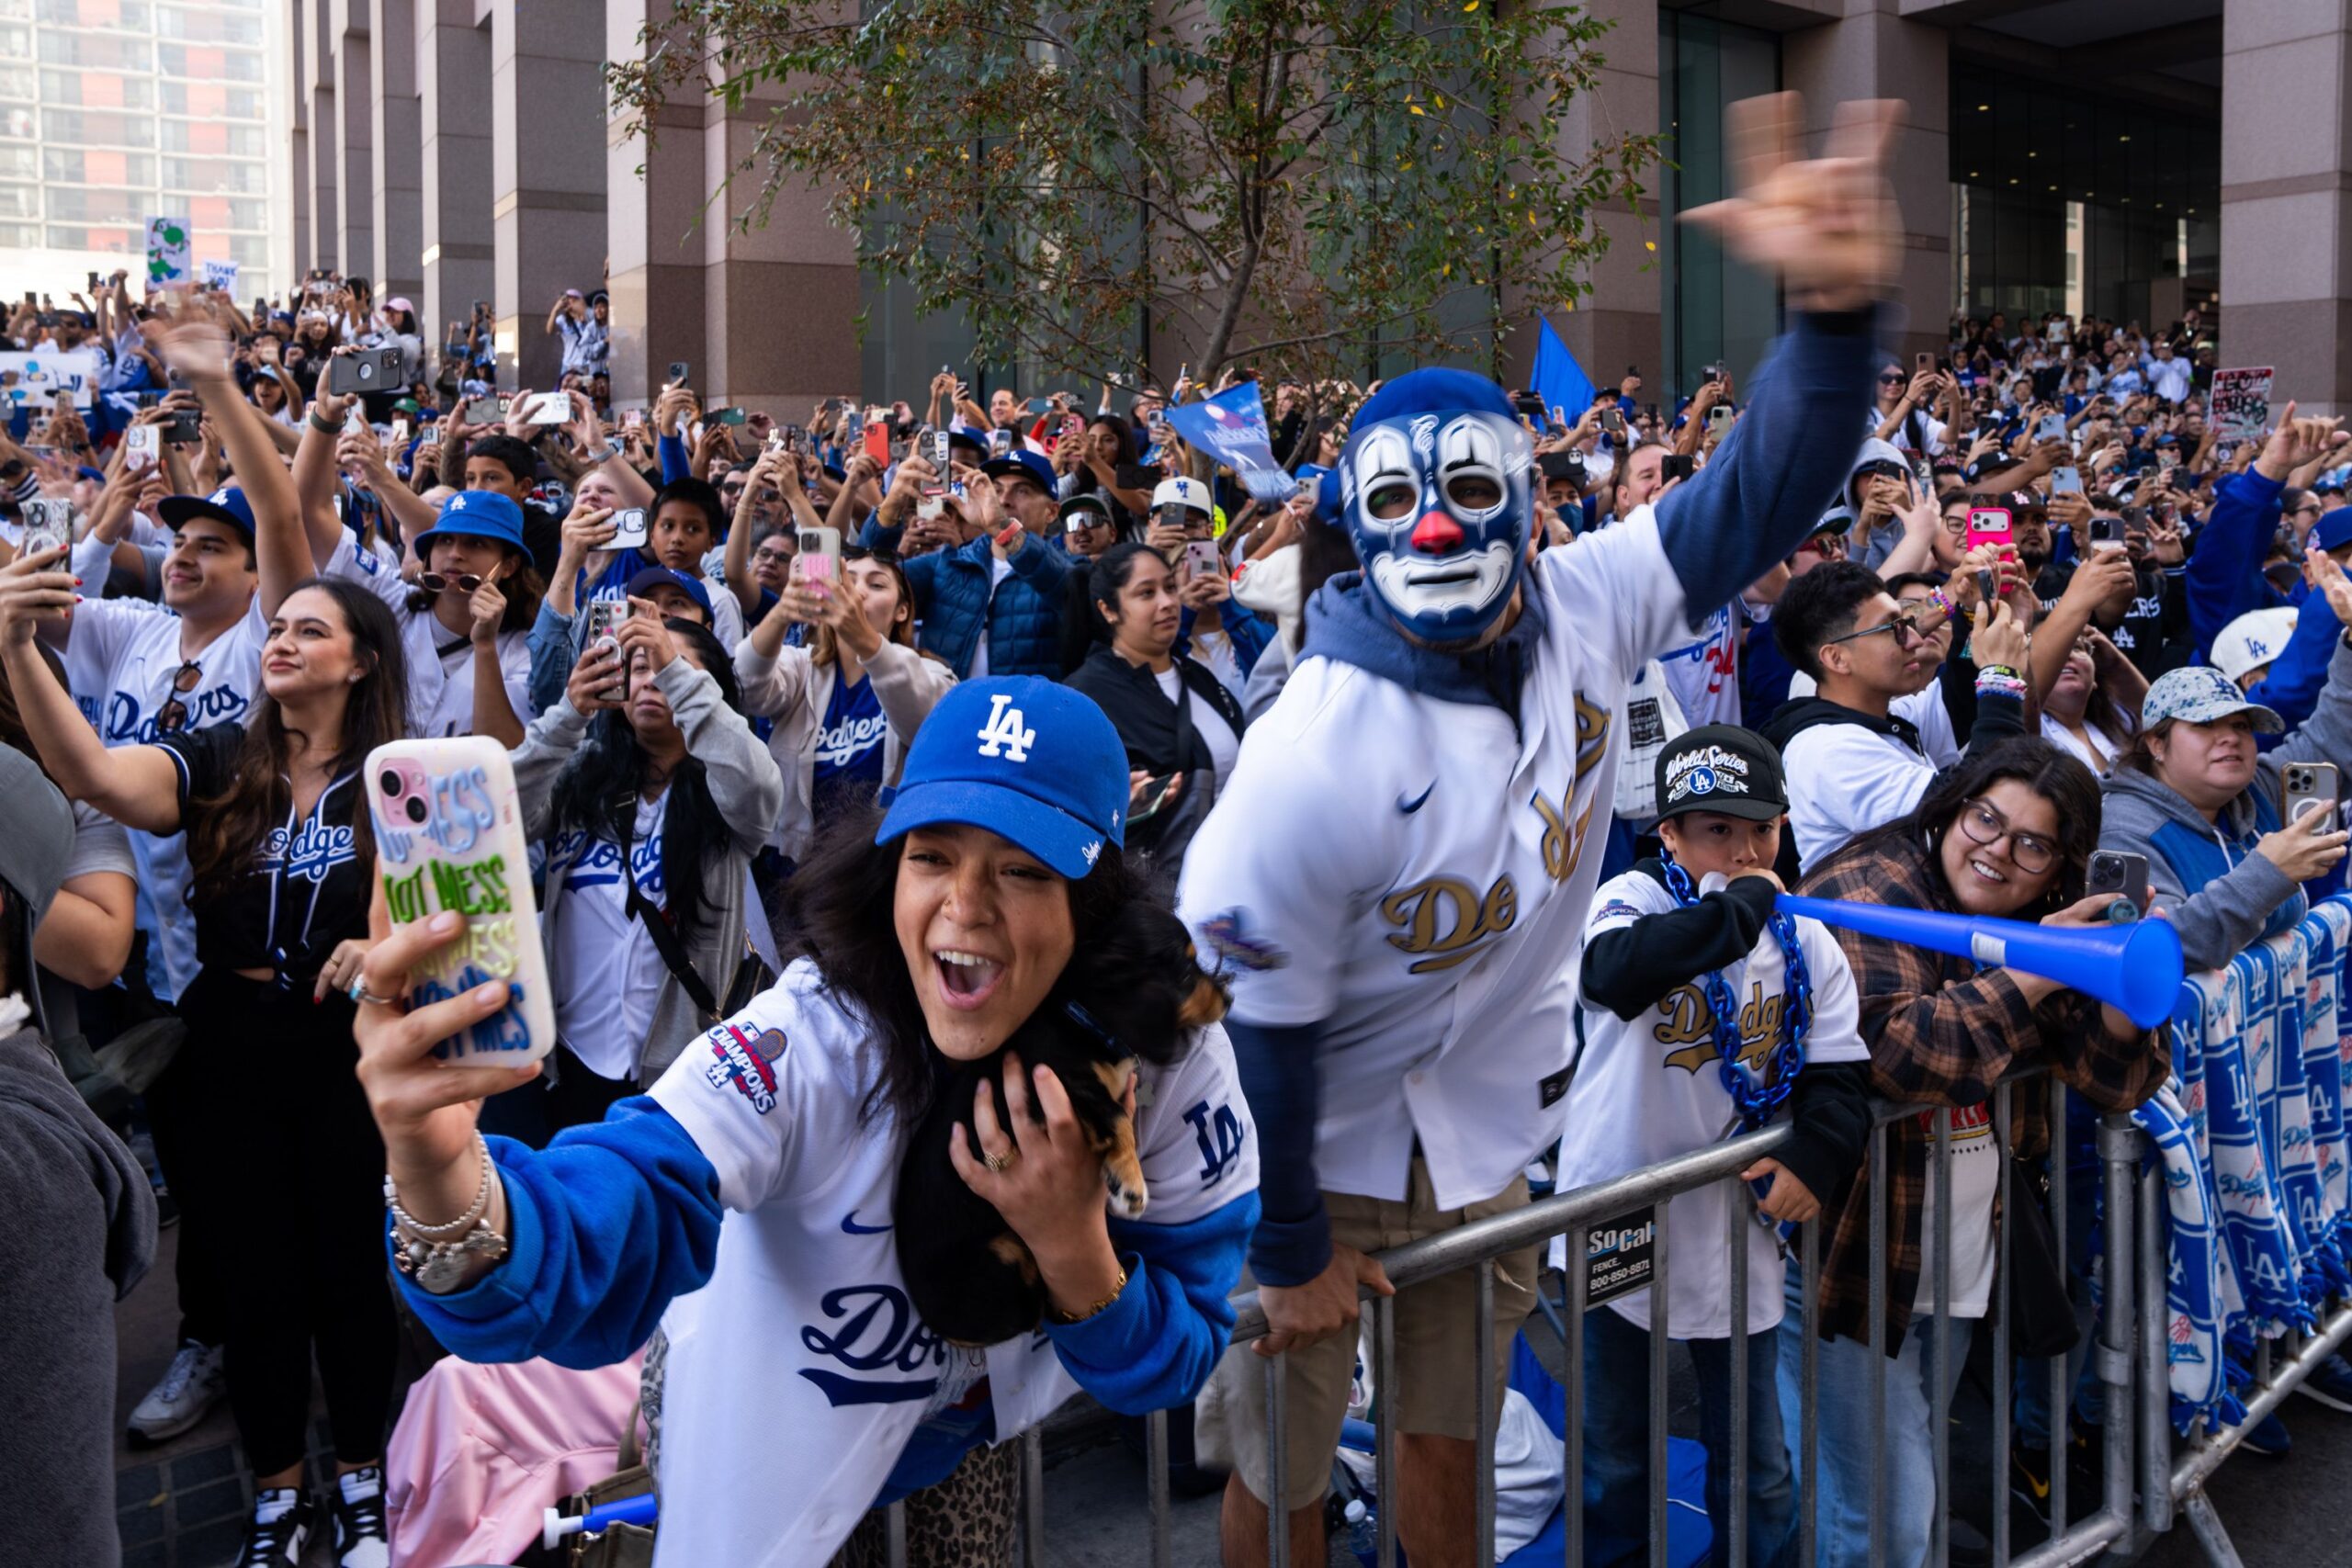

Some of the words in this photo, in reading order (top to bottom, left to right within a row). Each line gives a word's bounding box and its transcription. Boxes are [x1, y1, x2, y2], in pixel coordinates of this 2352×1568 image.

[2245, 637, 2267, 659] LA
[978, 694, 1036, 762] LA
[1666, 749, 1710, 787] World
[1709, 745, 1748, 775] Series
[1692, 771, 1711, 791] LA
[707, 1057, 734, 1088] LA
[708, 1024, 776, 1113] CHAMPIONS
[1182, 1100, 1244, 1191] LA
[1589, 1258, 1651, 1291] 800-850-8871
[2243, 1234, 2288, 1293] LA
